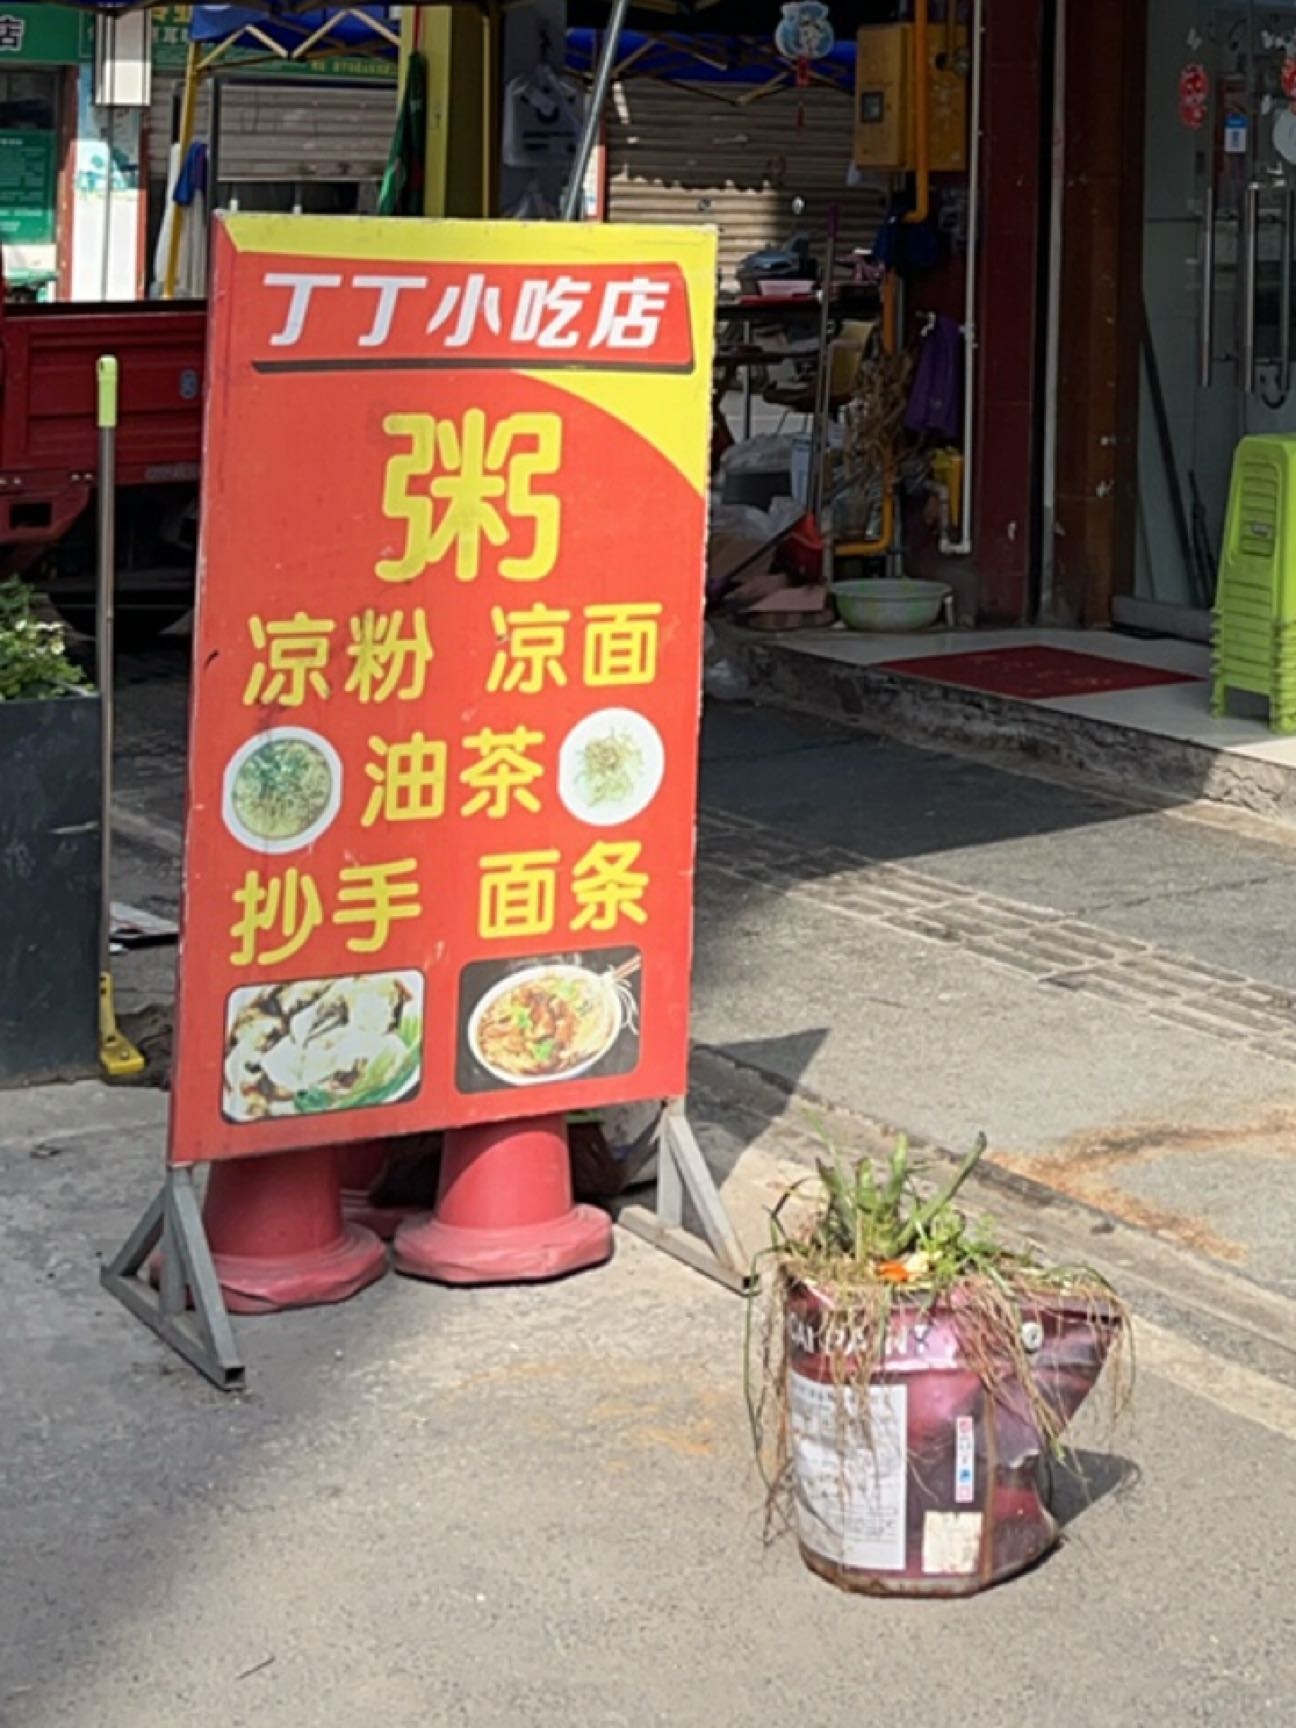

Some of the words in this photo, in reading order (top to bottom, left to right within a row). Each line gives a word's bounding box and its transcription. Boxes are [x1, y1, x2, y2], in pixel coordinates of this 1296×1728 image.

[261, 271, 672, 351] 丁丁小吃店
[373, 406, 564, 582] 粥
[241, 606, 432, 708] 凉粉
[485, 600, 663, 695] 凉面
[360, 724, 546, 826] 油茶
[230, 857, 423, 967] 抄手
[477, 840, 650, 941] 面条
